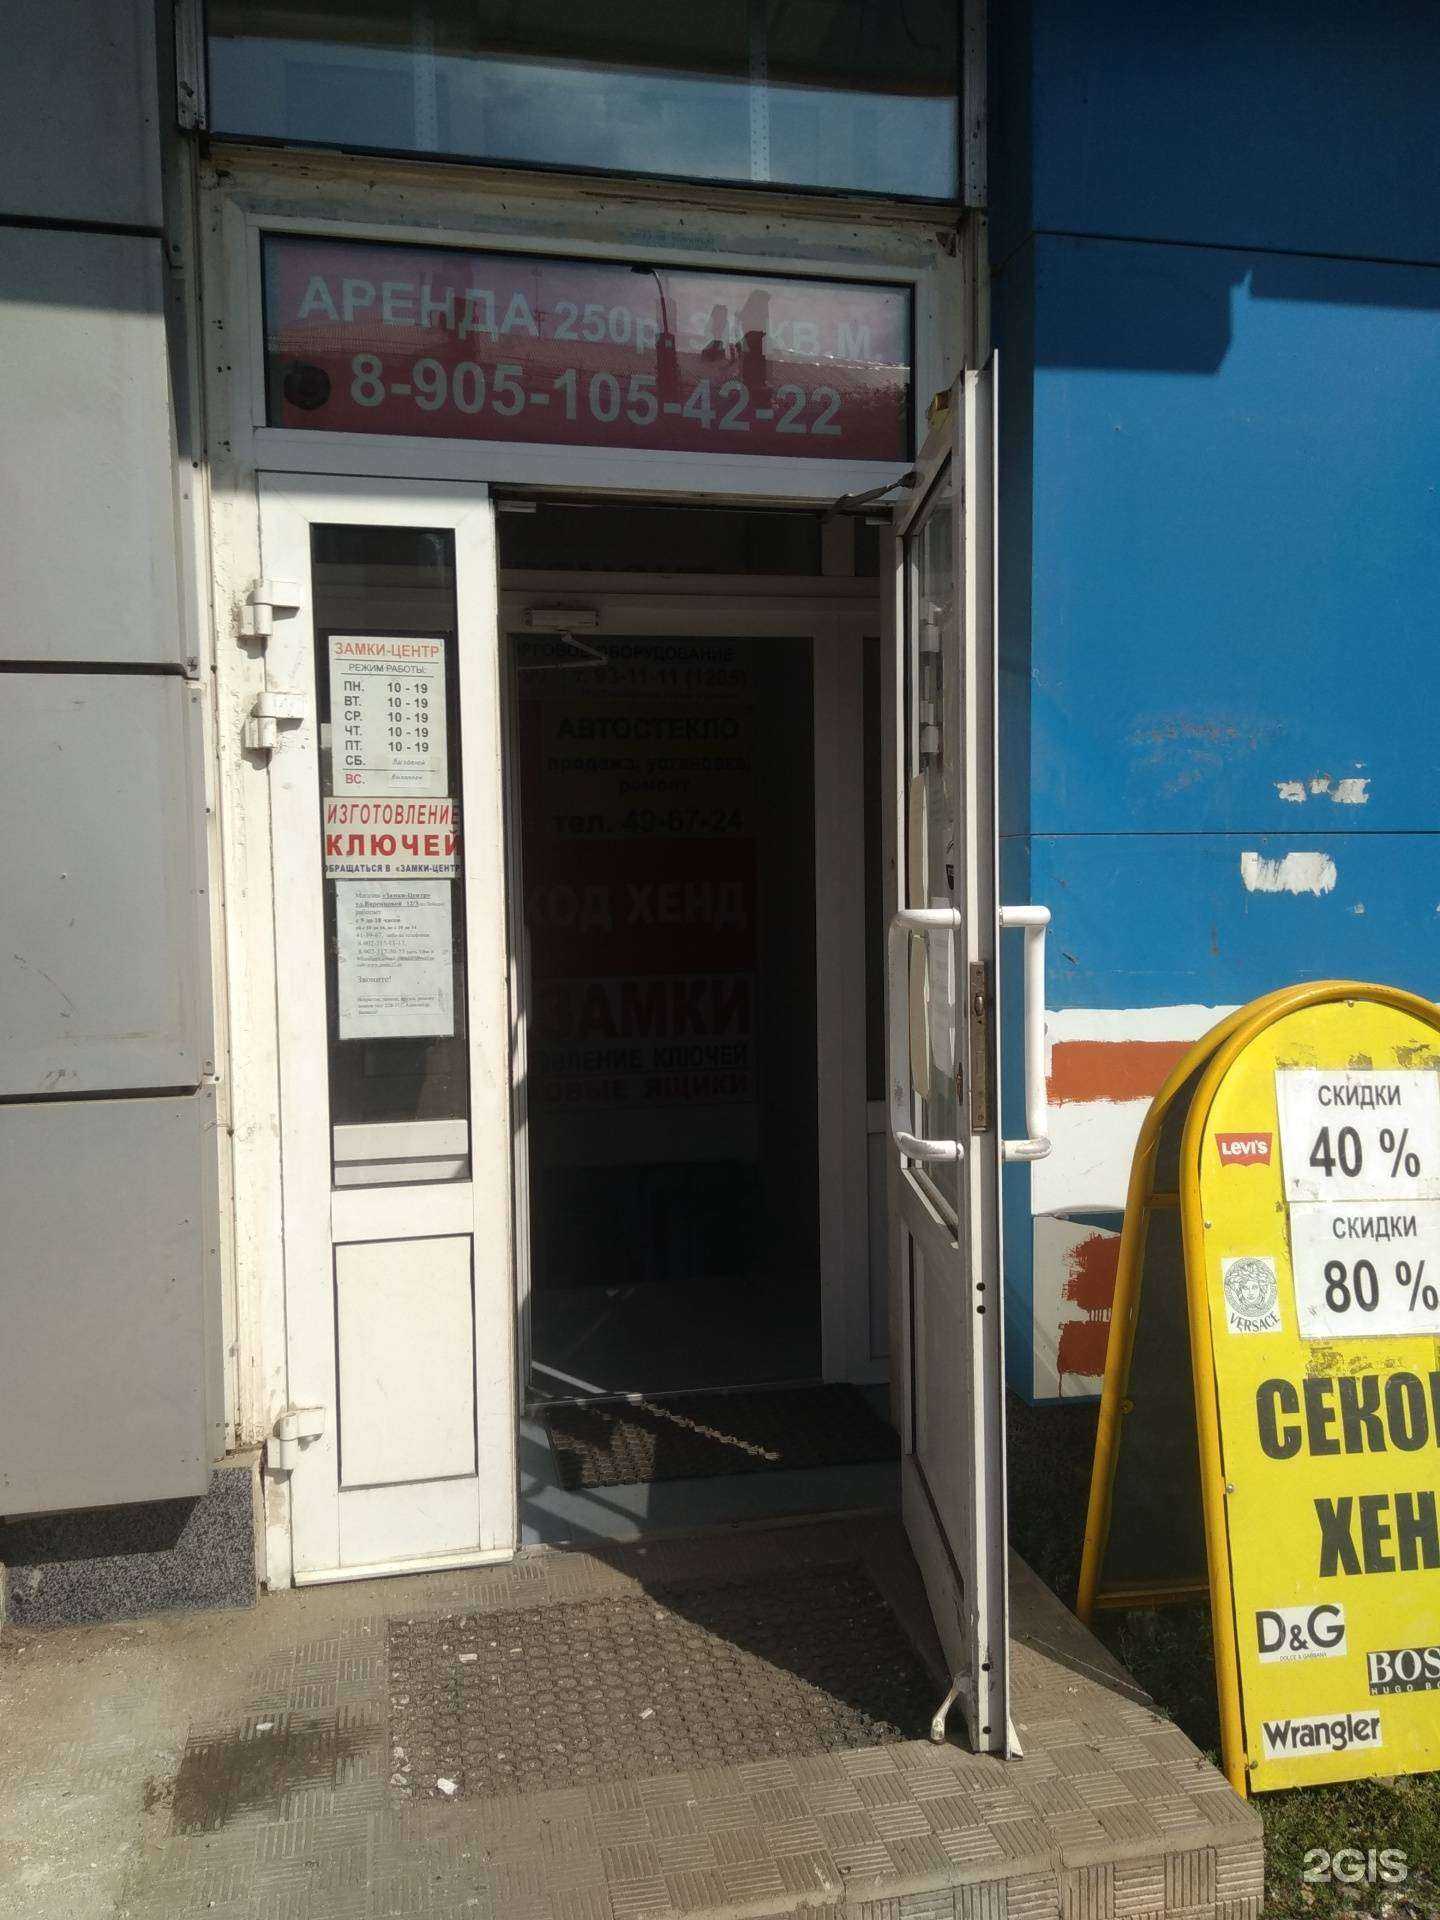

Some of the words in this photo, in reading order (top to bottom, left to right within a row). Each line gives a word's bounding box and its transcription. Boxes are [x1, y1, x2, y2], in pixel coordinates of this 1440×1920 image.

[298, 277, 540, 343] АРЕНДА
[350, 353, 843, 436] 8-905-105-42-22
[335, 642, 440, 659] ЗАМКИ-ЦЕНТР
[348, 663, 384, 672] РЕЖИМ
[344, 681, 364, 692] ПН.
[387, 683, 401, 693] 10
[414, 684, 428, 694] 19
[344, 696, 361, 706] ВТ.
[388, 698, 402, 708] 10
[414, 698, 428, 709] 19
[344, 711, 362, 721] СР.
[388, 712, 402, 722] 10
[414, 713, 428, 724] 19
[555, 717, 739, 740] АВТОСТЕКЛО
[345, 726, 362, 736] ЧТ.
[388, 727, 402, 737] 10
[415, 728, 429, 738] 19
[345, 740, 363, 750] ПТ.
[388, 742, 402, 752] 10
[415, 742, 429, 753] 19
[346, 755, 366, 766] СБ.
[346, 774, 366, 784] ВС.
[327, 804, 460, 825] ИЗГОТОВЛЕНИЕ
[326, 830, 461, 856] КЛЮЧЕЙ
[385, 864, 391, 872] В
[625, 882, 748, 935] ХЕНД
[654, 1043, 748, 1069] КЛЮЧЕЙ
[1318, 1085, 1402, 1110] СКИДКИ
[1309, 1126, 1362, 1177] 40
[1379, 1128, 1421, 1178] %
[1332, 1215, 1417, 1242] СКИДКИ
[1324, 1259, 1380, 1313] 80
[1395, 1260, 1440, 1312] %
[1230, 1311, 1280, 1333] VERSACE
[1256, 1371, 1440, 1460] СЕКО
[1313, 1491, 1440, 1578] ХЕН
[1256, 1604, 1345, 1653] D&G
[1371, 1684, 1414, 1696] HUGO
[1263, 1714, 1380, 1751] Wrangler
